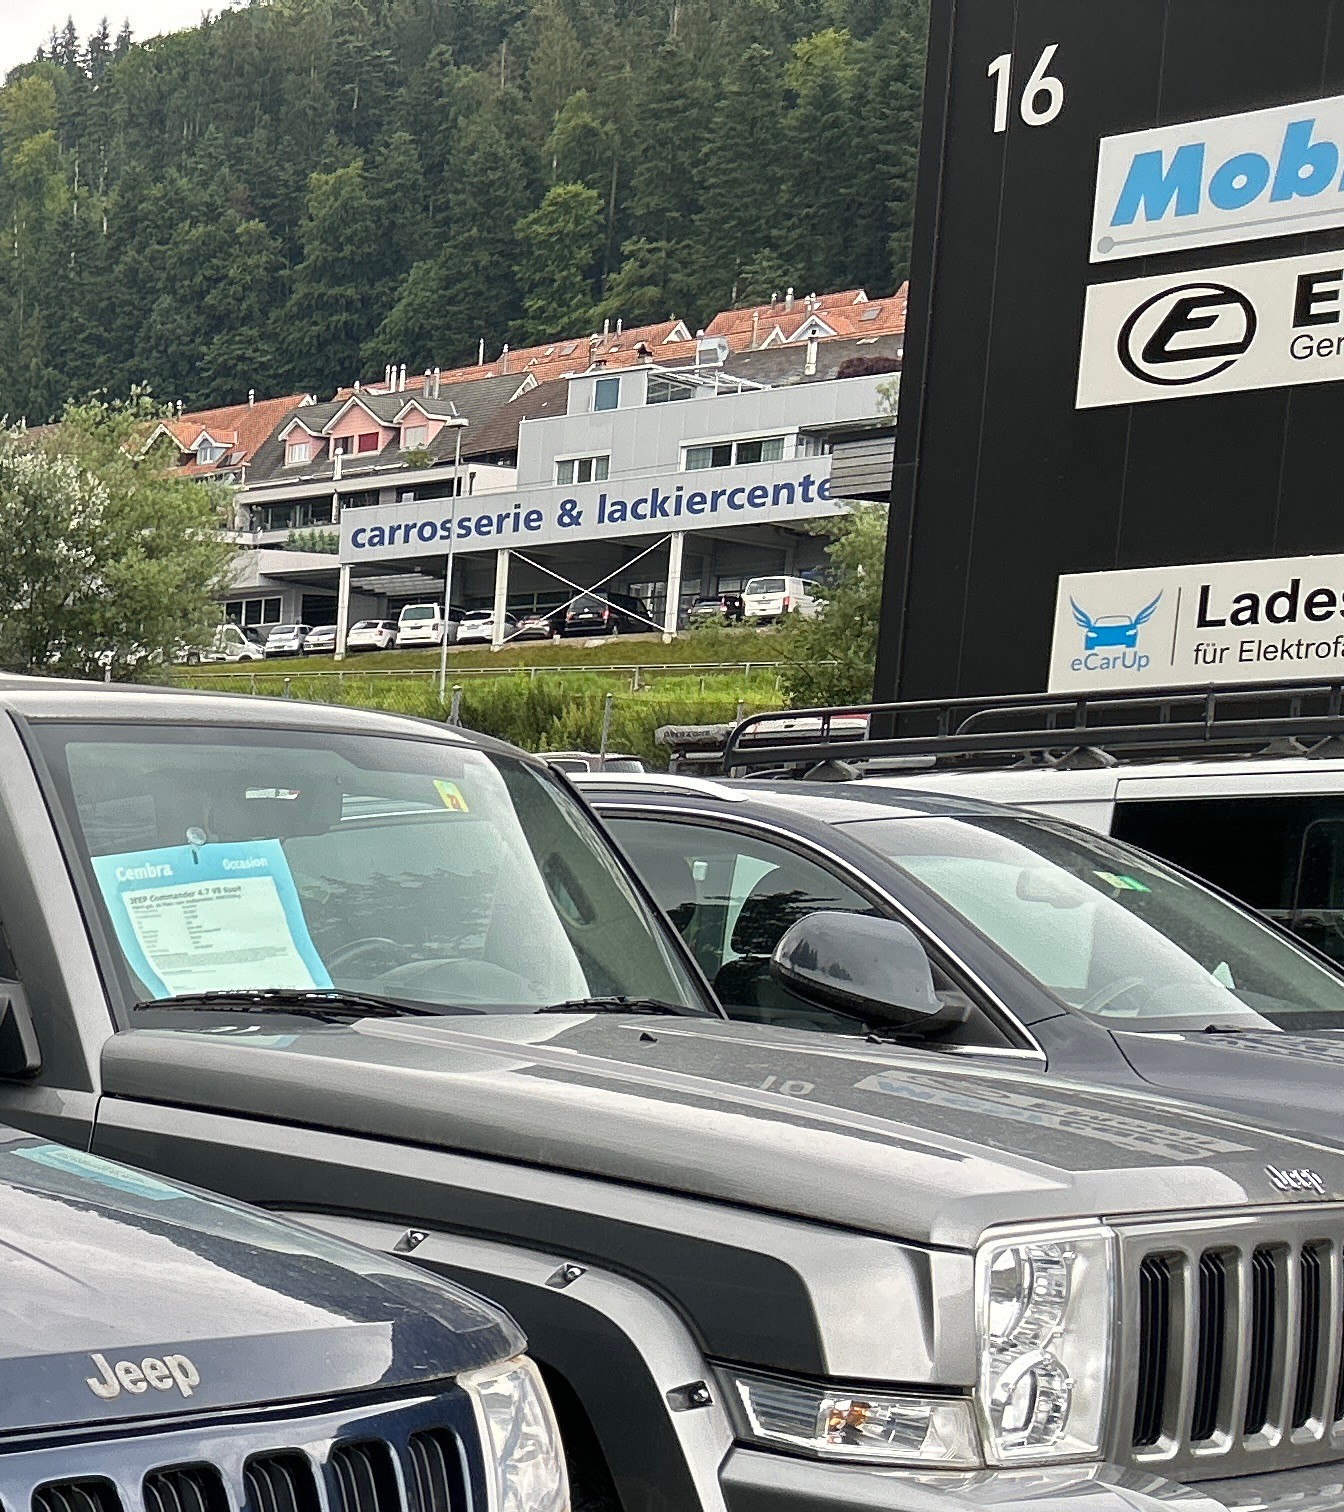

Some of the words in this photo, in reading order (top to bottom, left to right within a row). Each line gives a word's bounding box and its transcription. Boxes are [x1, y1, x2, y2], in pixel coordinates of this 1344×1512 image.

[988, 43, 1064, 133] 16
[1110, 117, 1344, 227] Mob
[351, 503, 543, 549] carrosserie
[558, 497, 582, 528] &
[596, 473, 833, 525] lackiercente
[1196, 577, 1344, 629] Lade
[1070, 650, 1150, 672] eCarUp
[1194, 643, 1230, 665] für
[1238, 634, 1344, 664] Elektrof
[115, 862, 174, 882] Cembra
[222, 856, 268, 871] Occasion
[149, 889, 196, 903] Commander
[85, 1352, 201, 1400] Jeep
